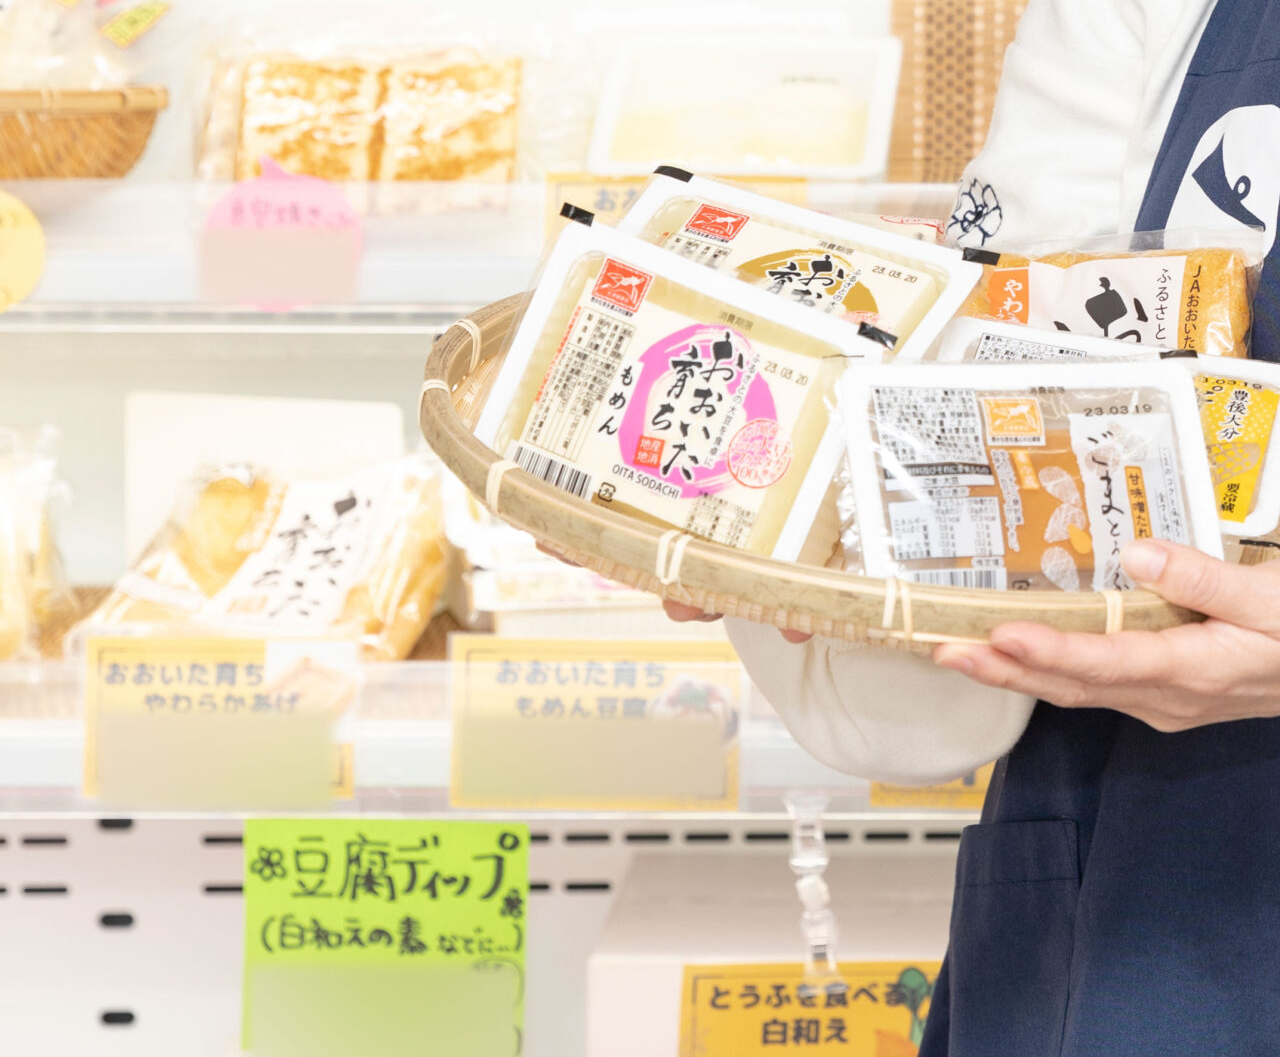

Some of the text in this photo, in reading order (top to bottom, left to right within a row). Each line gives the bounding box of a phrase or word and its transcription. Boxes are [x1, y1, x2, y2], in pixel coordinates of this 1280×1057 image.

[871, 264, 918, 284] 23.03.20
[1183, 264, 1202, 350] JAおおいた
[597, 364, 634, 437] もめん
[612, 463, 680, 500] OITA SODACHI
[105, 661, 265, 687] おおいた育ち
[495, 659, 667, 688] おおいた育ち
[290, 832, 522, 902] 豆腐ディップ
[761, 1017, 850, 1045] 白和え
